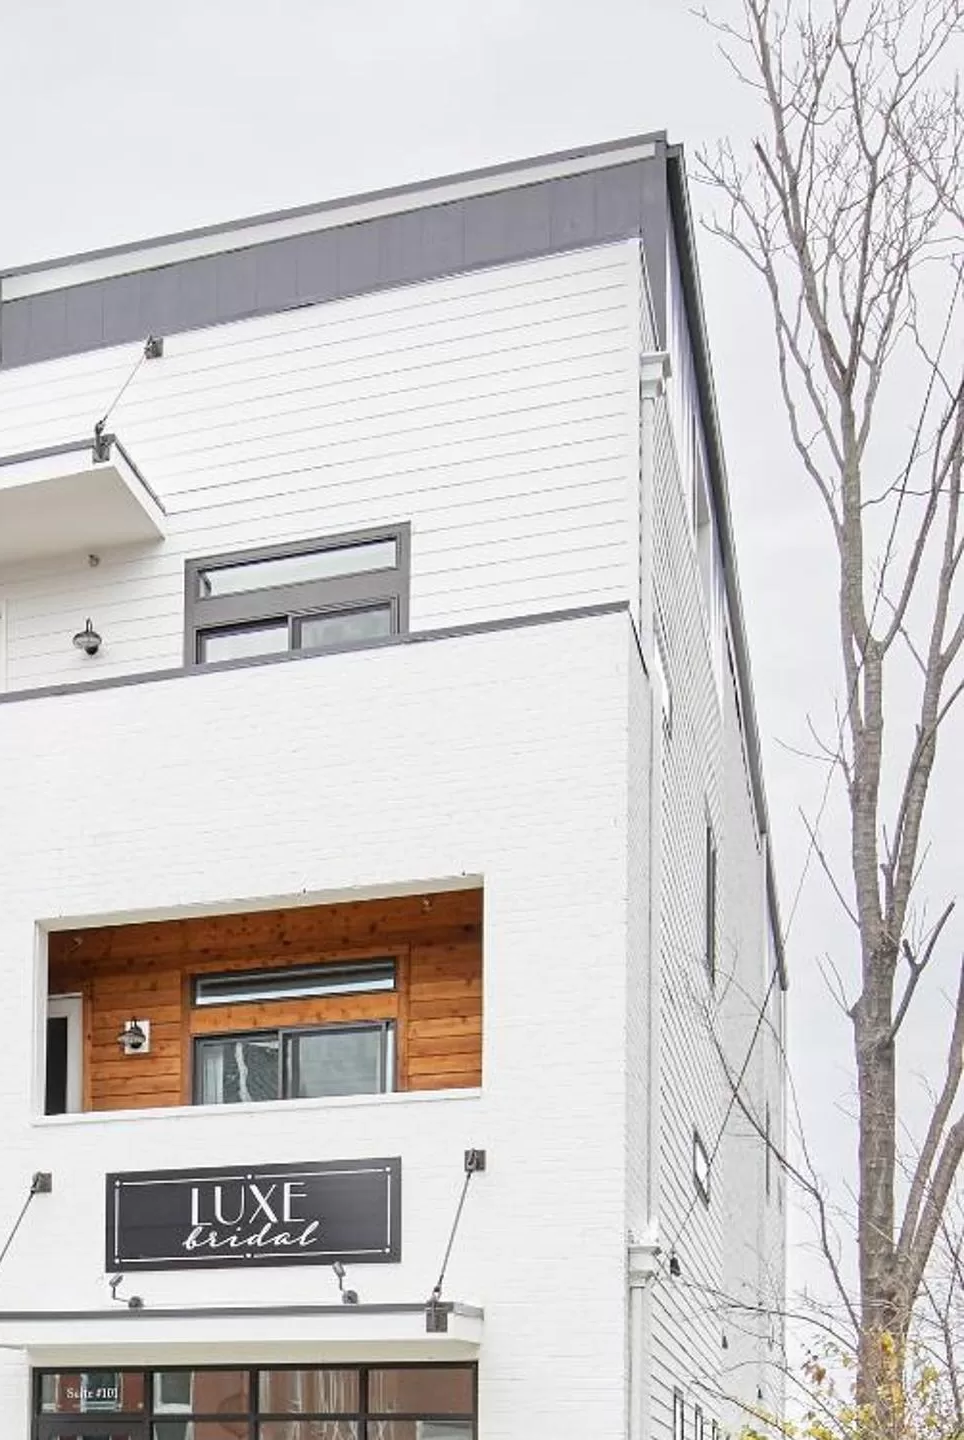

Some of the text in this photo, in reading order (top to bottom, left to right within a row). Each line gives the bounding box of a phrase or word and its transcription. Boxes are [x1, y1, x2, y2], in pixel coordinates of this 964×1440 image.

[191, 1181, 308, 1226] LUXE
[182, 1220, 320, 1251] bridal
[66, 1387, 118, 1399] Suite #101
